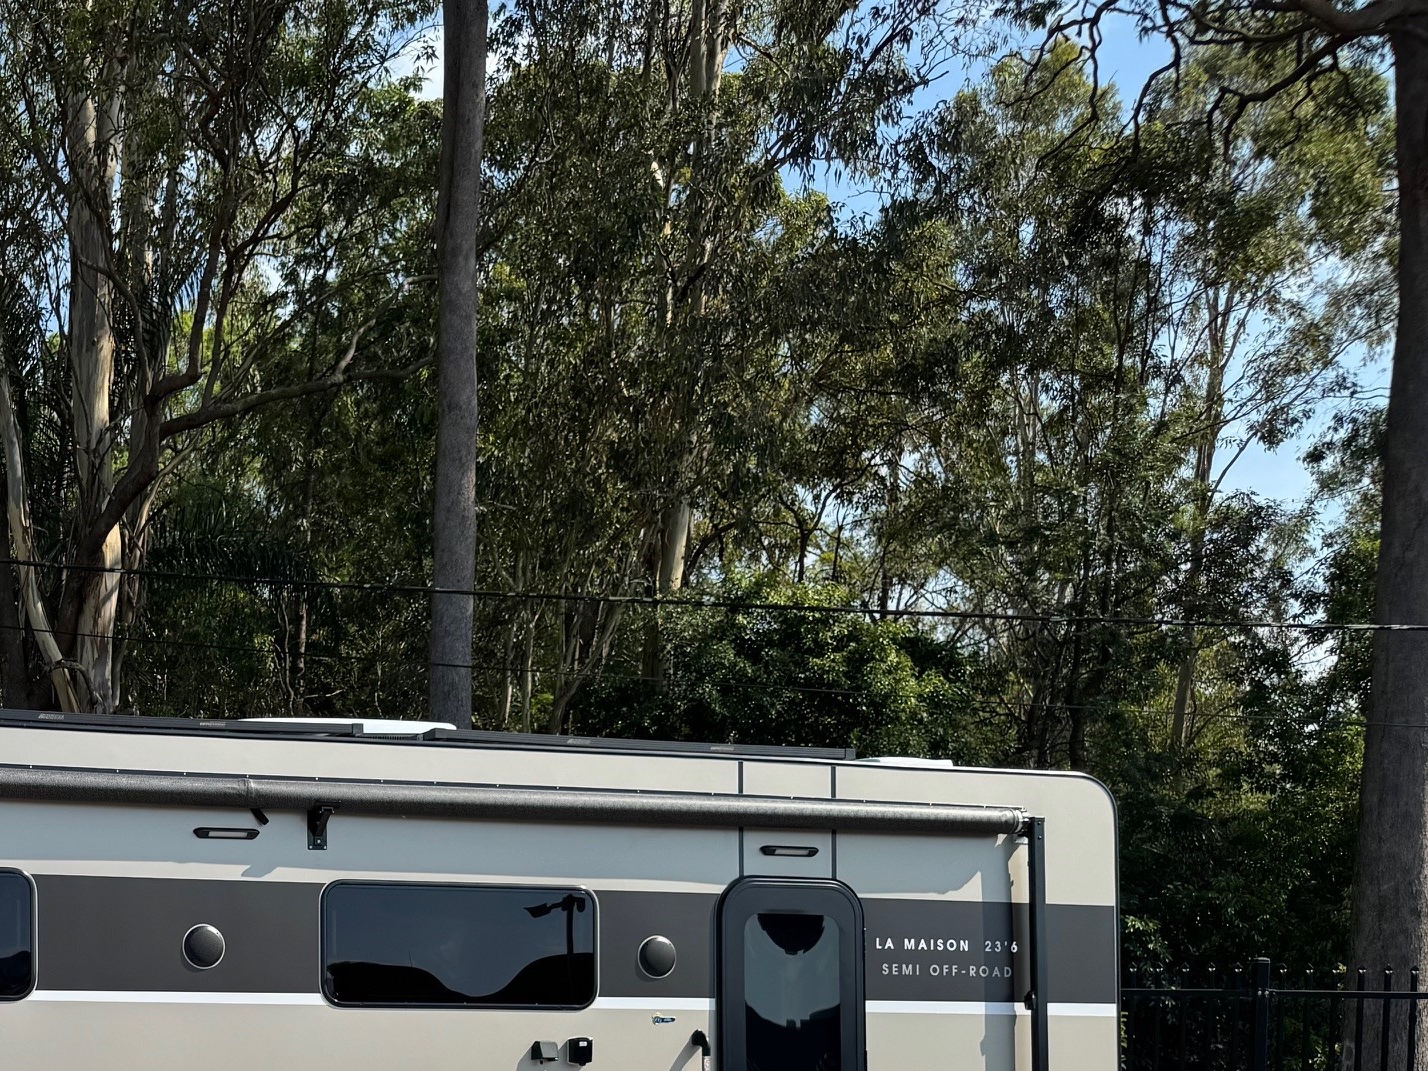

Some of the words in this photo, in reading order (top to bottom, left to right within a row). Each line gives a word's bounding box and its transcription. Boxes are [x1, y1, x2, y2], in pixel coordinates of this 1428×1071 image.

[876, 937, 894, 950] LA
[904, 938, 970, 952] MAISON
[984, 939, 1019, 953] 23'6
[881, 963, 920, 976] SEMI
[929, 964, 1012, 978] OFF-ROAD
